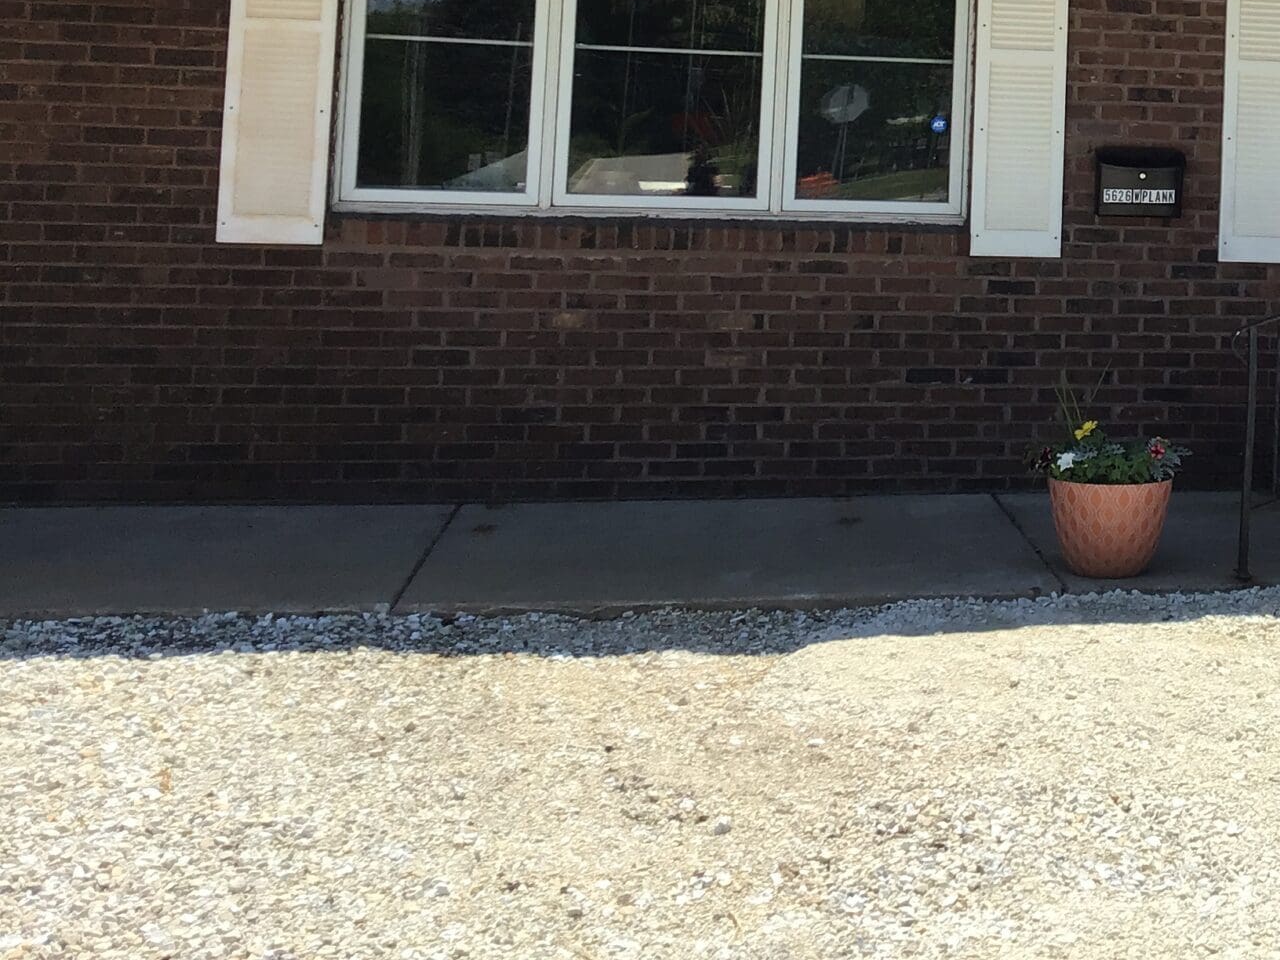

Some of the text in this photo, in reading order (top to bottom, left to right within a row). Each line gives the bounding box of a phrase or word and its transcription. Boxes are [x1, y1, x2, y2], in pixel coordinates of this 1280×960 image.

[1105, 190, 1174, 202] 5626 W PLANK
